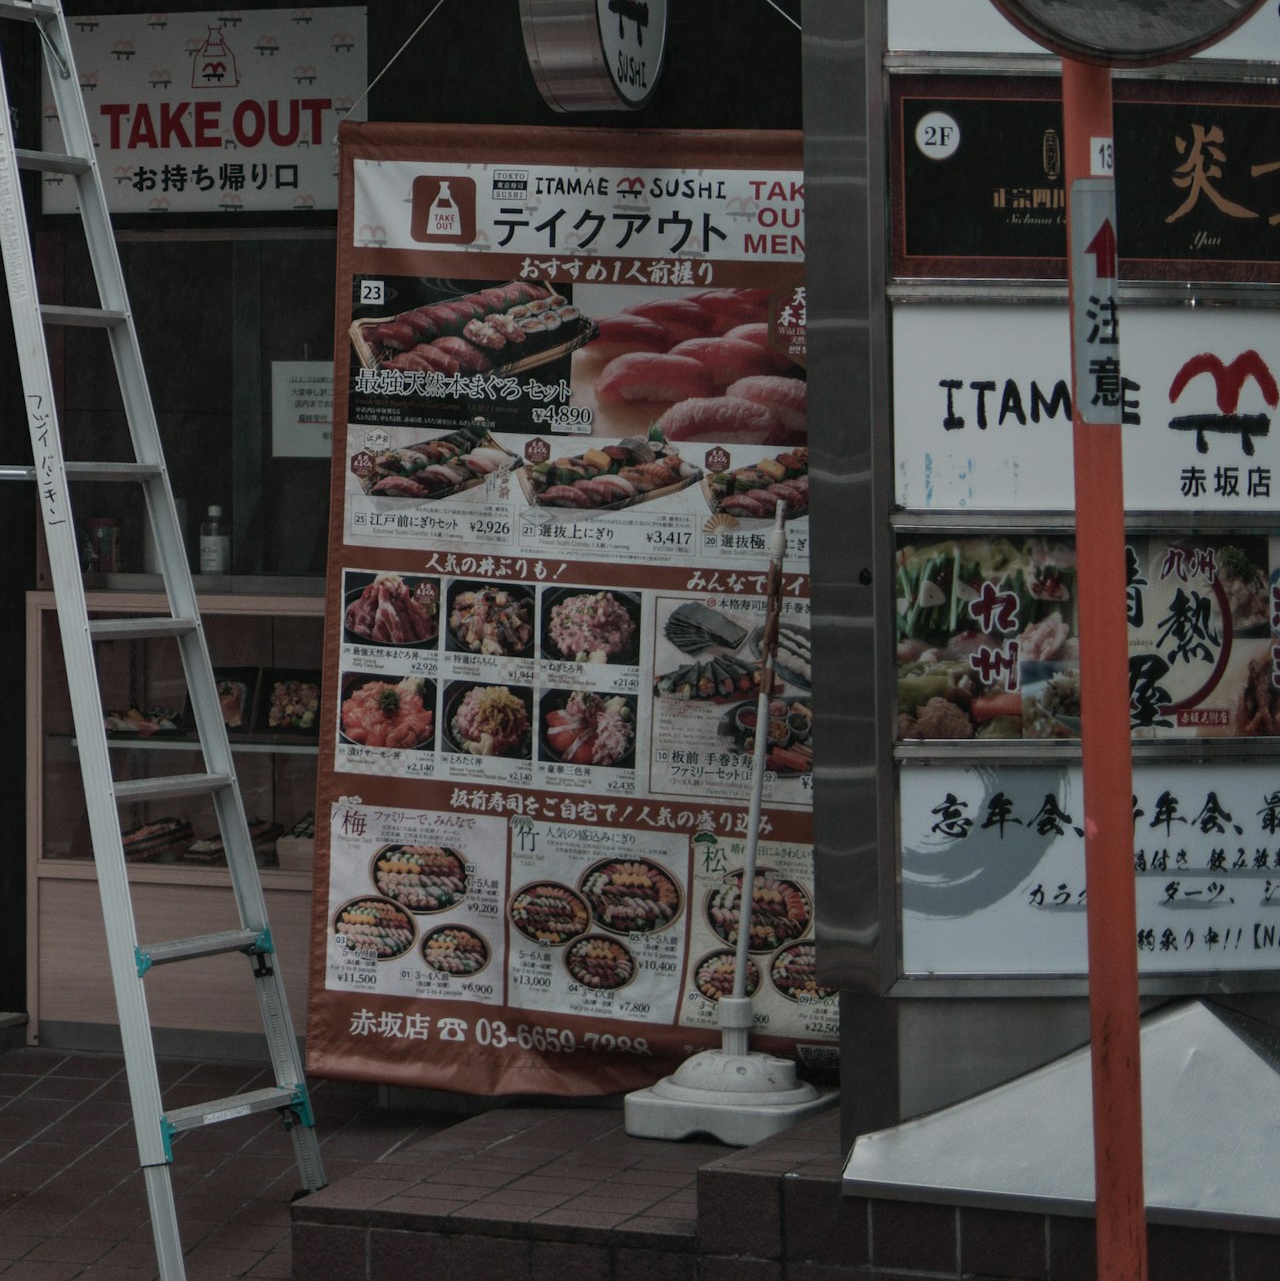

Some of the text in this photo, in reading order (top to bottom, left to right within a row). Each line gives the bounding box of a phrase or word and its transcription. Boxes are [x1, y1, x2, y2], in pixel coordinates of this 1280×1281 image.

[617, 49, 647, 89] SUSHI
[100, 98, 333, 150] TAKE OUT
[924, 125, 954, 147] 2F
[131, 163, 299, 192] お持ち帰り口
[496, 172, 526, 180] TOKYO
[496, 190, 524, 199] SUSHI
[535, 177, 727, 200] ITAMAE SUSHI
[434, 213, 456, 222] TAKE
[757, 207, 806, 229] OU
[435, 222, 454, 231] OUT
[494, 208, 728, 254] テイクアウト
[519, 256, 714, 285] おすすめ1人前握り
[362, 285, 382, 300] 23
[1085, 294, 1121, 407] 注意
[355, 368, 573, 404] 最強天然本まぐろセット
[938, 377, 1141, 432] ITAME
[532, 405, 592, 425] ¥4,890
[1180, 466, 1272, 498] 赤坂店
[356, 515, 366, 524] 25
[369, 513, 458, 531] 江戸前にぎりセット
[469, 520, 510, 535] ¥2,926
[524, 526, 534, 535] 21
[538, 524, 614, 541] 選抜上にぎり
[646, 530, 692, 546] ¥3,417
[706, 537, 716, 546] 20
[1161, 547, 1218, 584] 九州
[969, 581, 1020, 694] 九州
[657, 752, 668, 760] 10
[671, 750, 699, 766] 板前
[608, 781, 636, 791] ¥2,435
[342, 810, 368, 837] 梅
[516, 826, 540, 853] 竹
[702, 846, 728, 874] 松
[467, 903, 499, 915] ¥9,200
[638, 961, 677, 973] ¥10,400
[337, 973, 377, 985] ¥11,500
[513, 975, 552, 988] ¥13,000
[462, 983, 493, 995] ¥6,900
[619, 1002, 650, 1014] ¥7,800
[349, 1008, 432, 1040] 赤坂店
